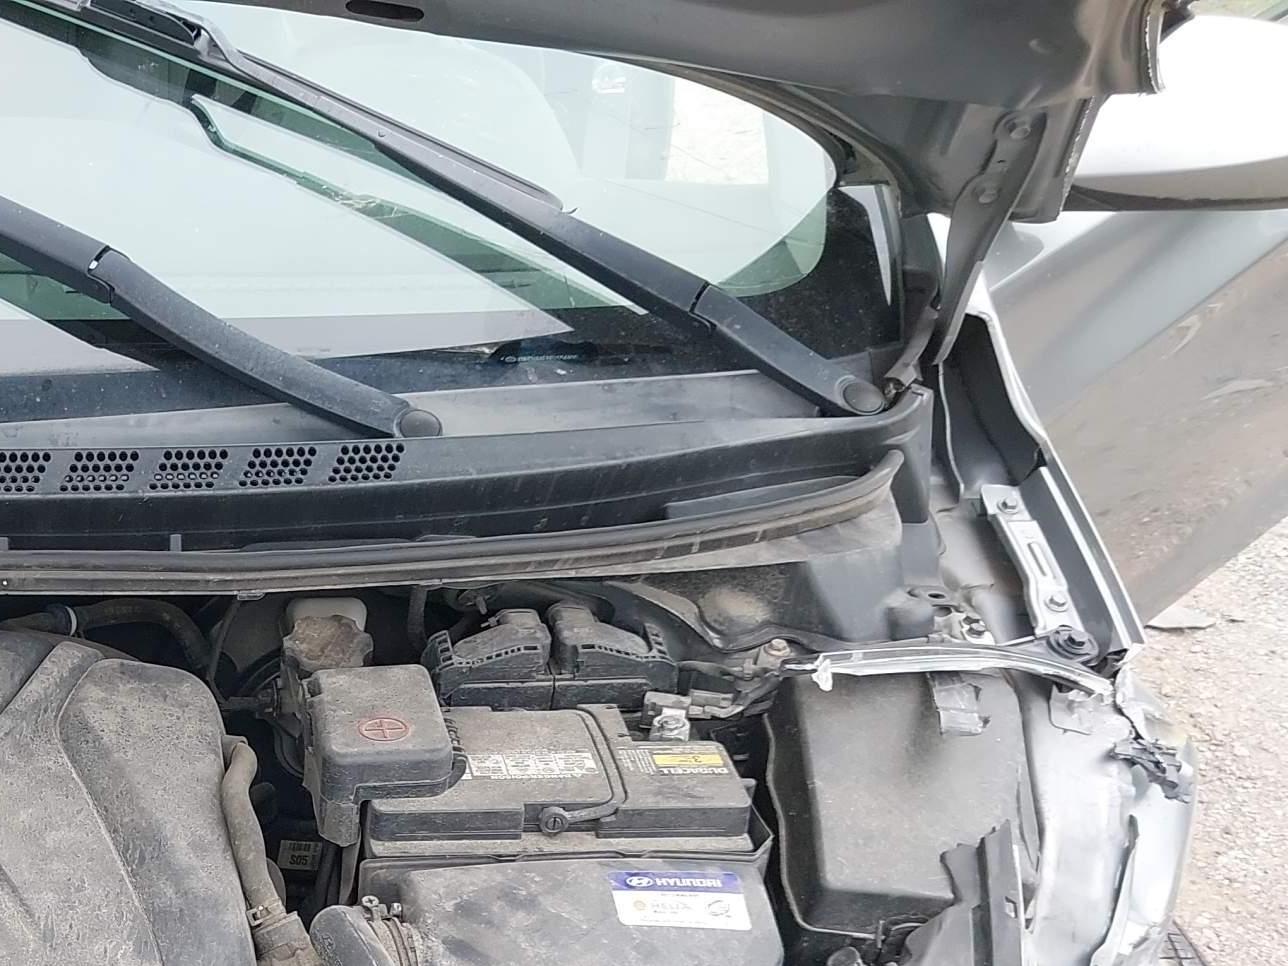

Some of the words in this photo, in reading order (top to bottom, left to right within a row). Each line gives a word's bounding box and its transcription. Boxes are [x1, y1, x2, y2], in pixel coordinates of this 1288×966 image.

[658, 767, 729, 775] DURACELL
[289, 854, 309, 865] S05
[655, 877, 723, 888] HYUNDAI
